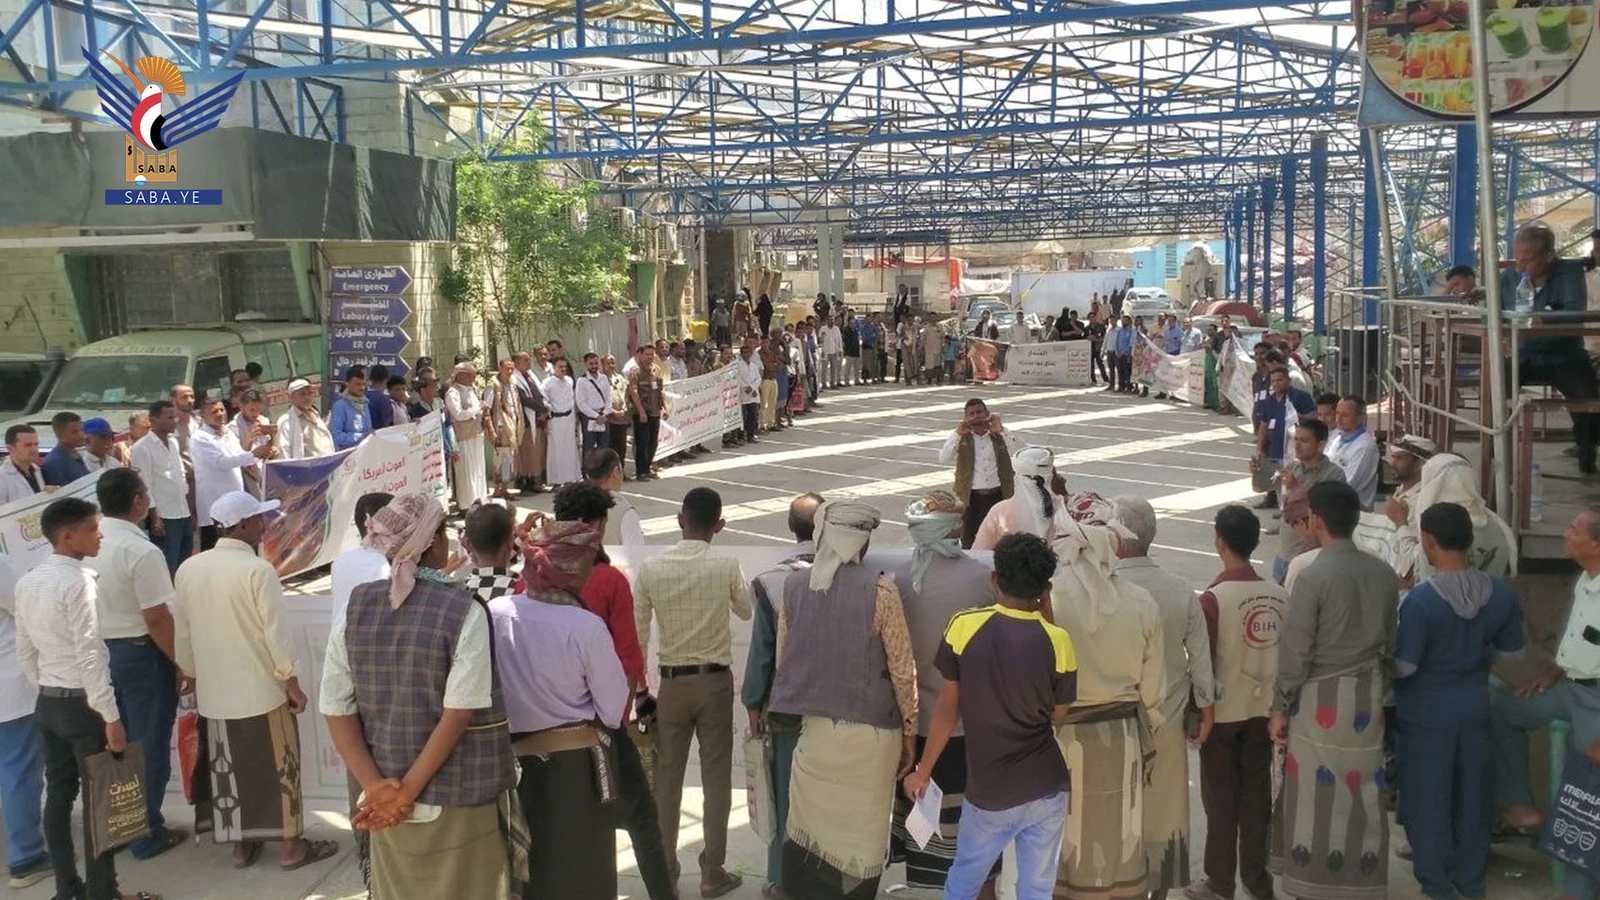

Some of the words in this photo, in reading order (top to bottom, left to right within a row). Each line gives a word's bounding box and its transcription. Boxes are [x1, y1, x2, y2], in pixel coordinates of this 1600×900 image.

[343, 283, 390, 292] Emergency
[341, 312, 389, 322] Laboratory
[352, 340, 364, 349] ER
[365, 340, 378, 350] OT
[1254, 621, 1276, 631] BIH
